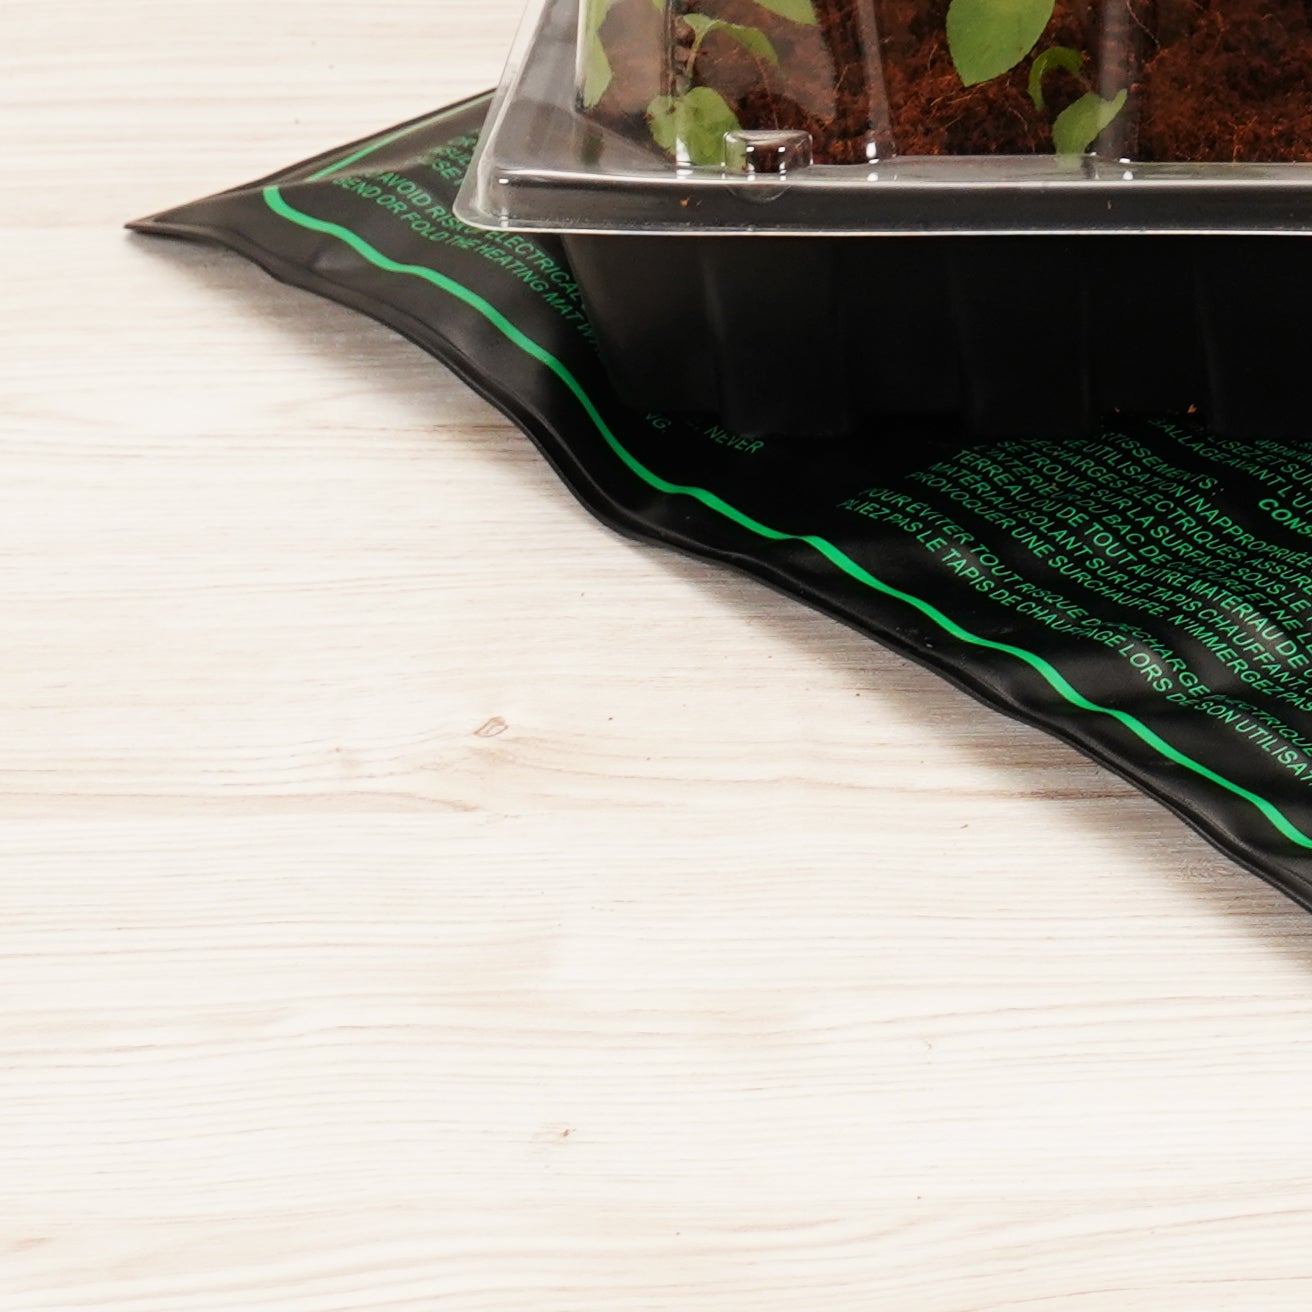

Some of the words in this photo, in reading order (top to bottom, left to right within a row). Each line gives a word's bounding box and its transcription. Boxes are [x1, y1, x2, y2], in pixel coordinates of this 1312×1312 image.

[376, 194, 407, 214] OR
[400, 211, 449, 242] FOLD
[475, 243, 549, 292] HEATING
[541, 291, 583, 320] MAT
[380, 172, 432, 206] AVOID
[484, 231, 581, 301] ELECTRICAL
[1082, 442, 1189, 498] UTILISATION
[911, 472, 1017, 528] PROVOQUER
[1011, 527, 1055, 558] UNE
[1047, 555, 1170, 616] SURCHAUFFE.
[1168, 614, 1285, 695] N'IMMERGEZ
